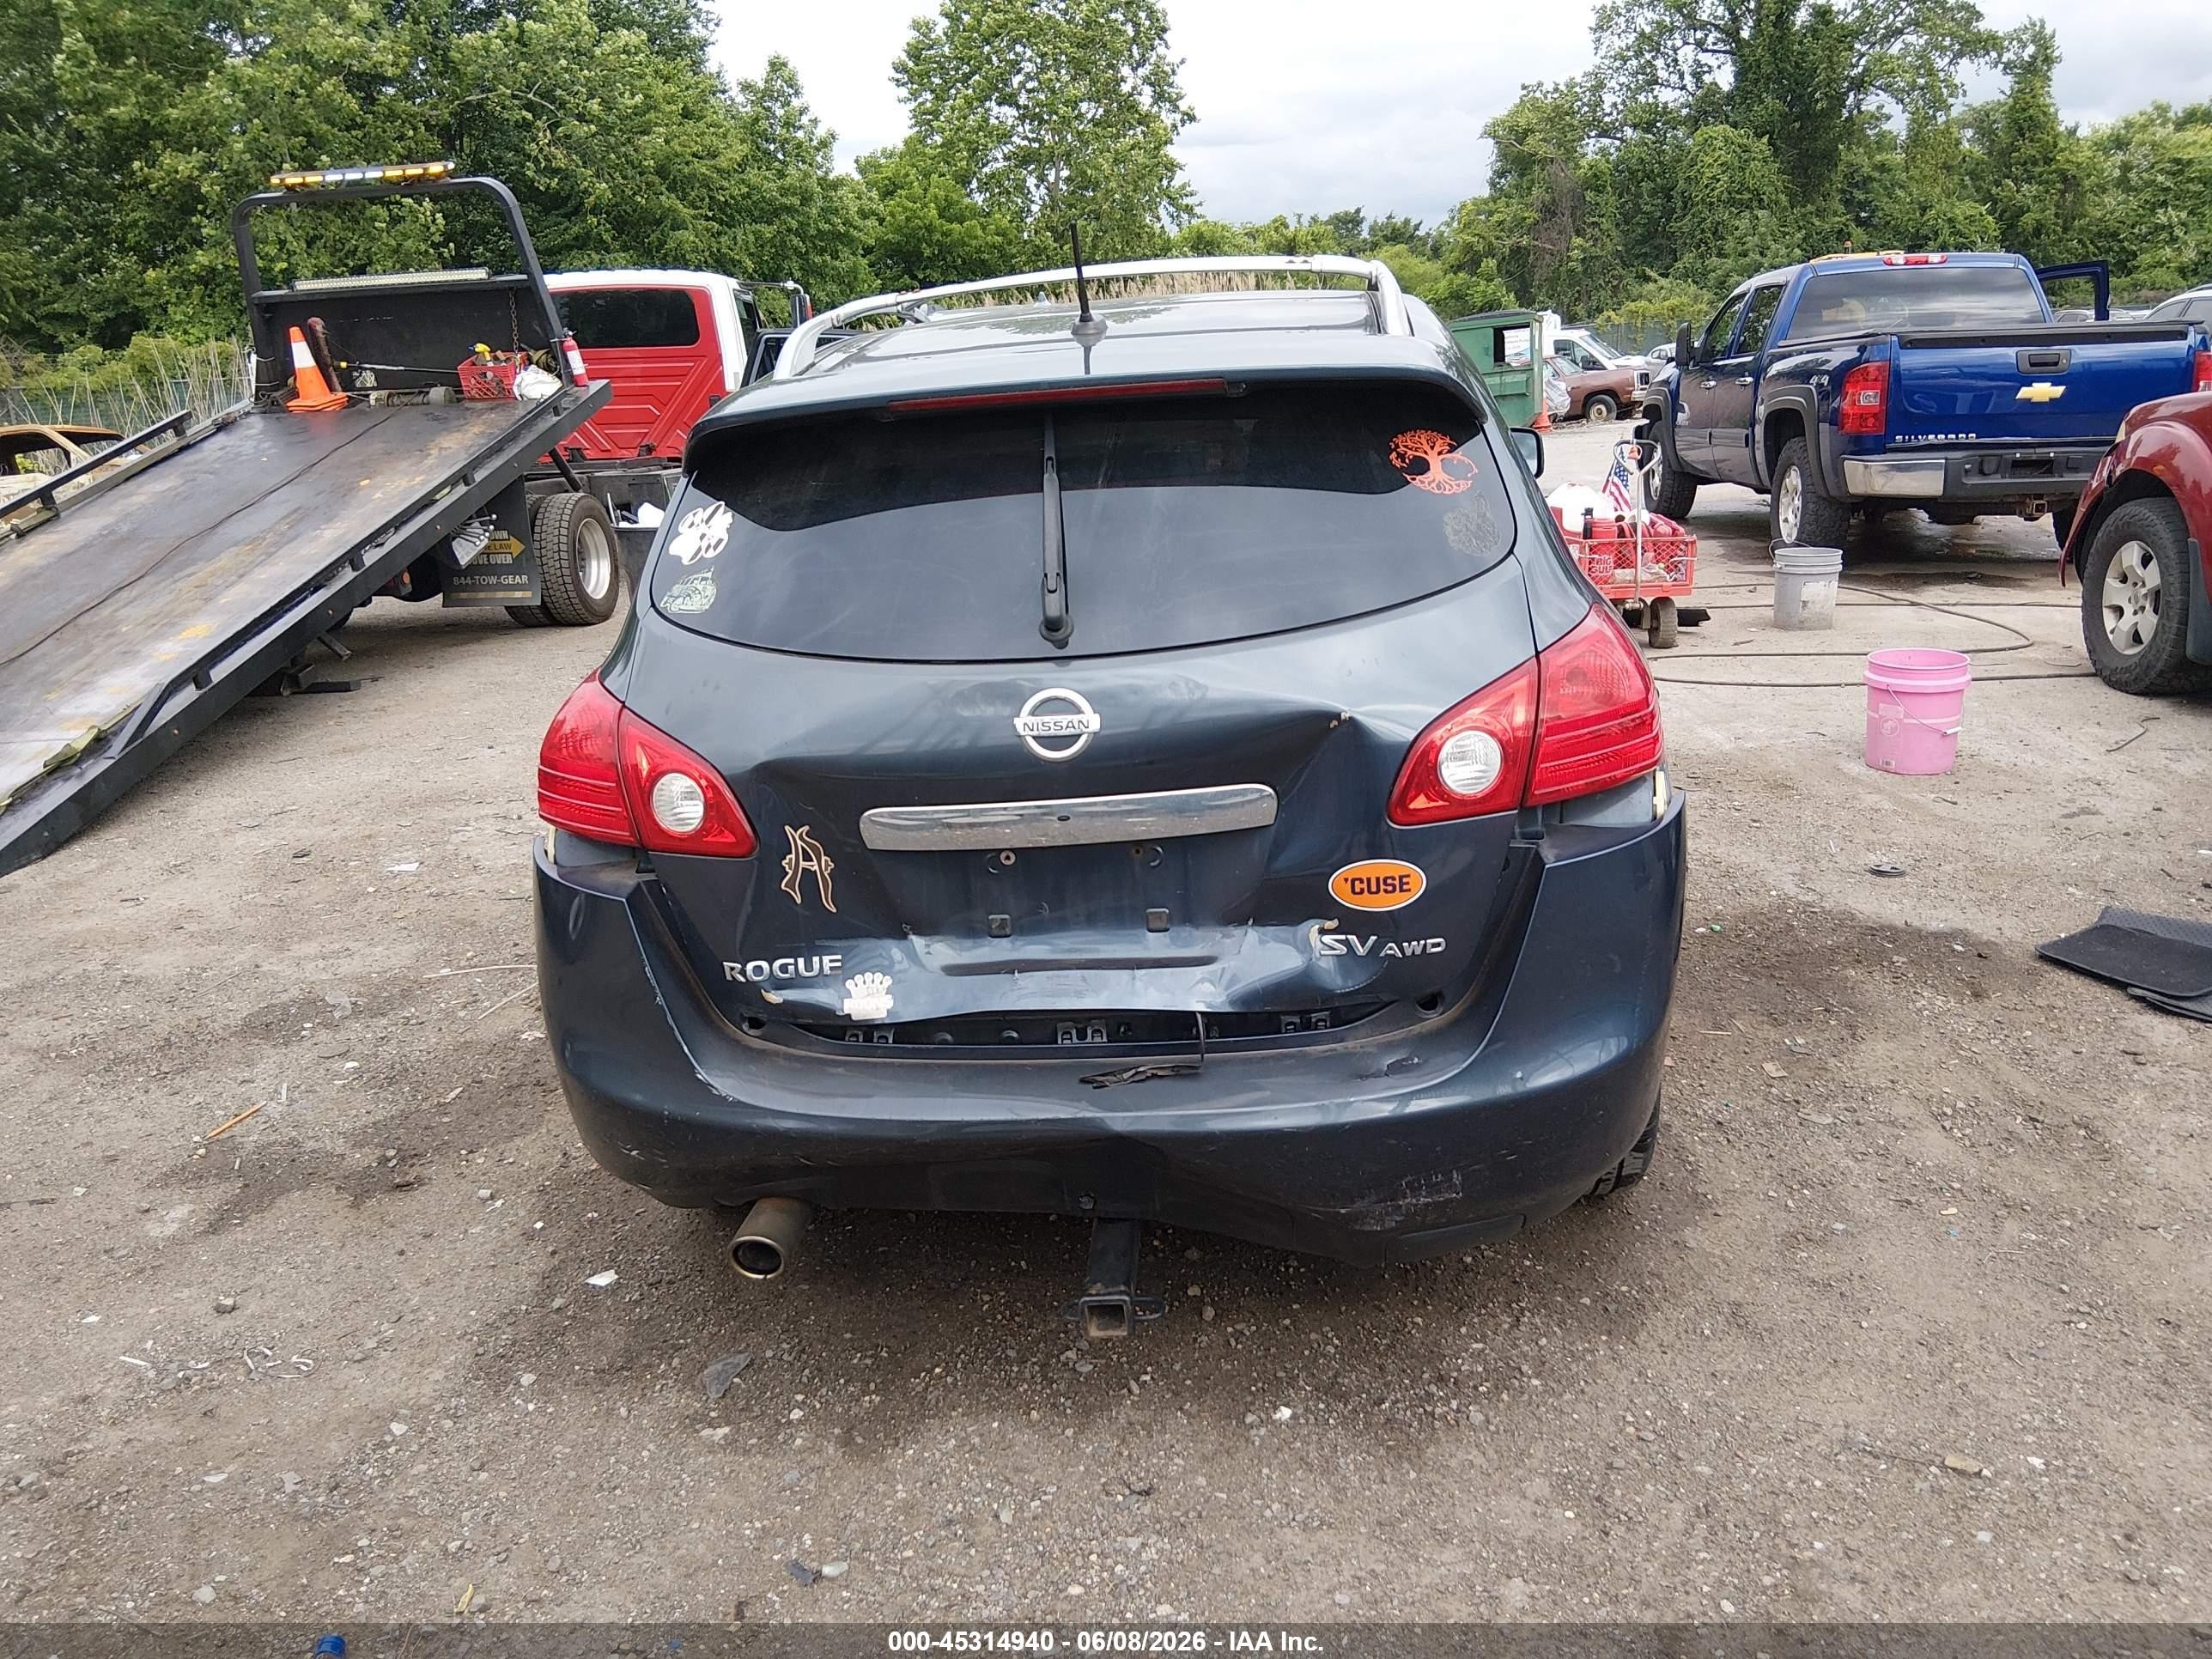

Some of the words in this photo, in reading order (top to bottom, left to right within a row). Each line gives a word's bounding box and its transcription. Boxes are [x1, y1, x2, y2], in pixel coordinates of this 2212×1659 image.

[489, 529, 509, 540] OWN
[494, 542, 513, 550] LAW
[471, 553, 489, 565] OVE
[489, 552, 514, 564] OVER
[453, 574, 529, 586] 844-TOW-GEAR
[1023, 719, 1090, 732] NISSAN
[1343, 874, 1412, 896] 'CUSE
[1319, 934, 1377, 957] SV
[1378, 938, 1447, 958] AWD
[722, 954, 842, 983] ROGUE
